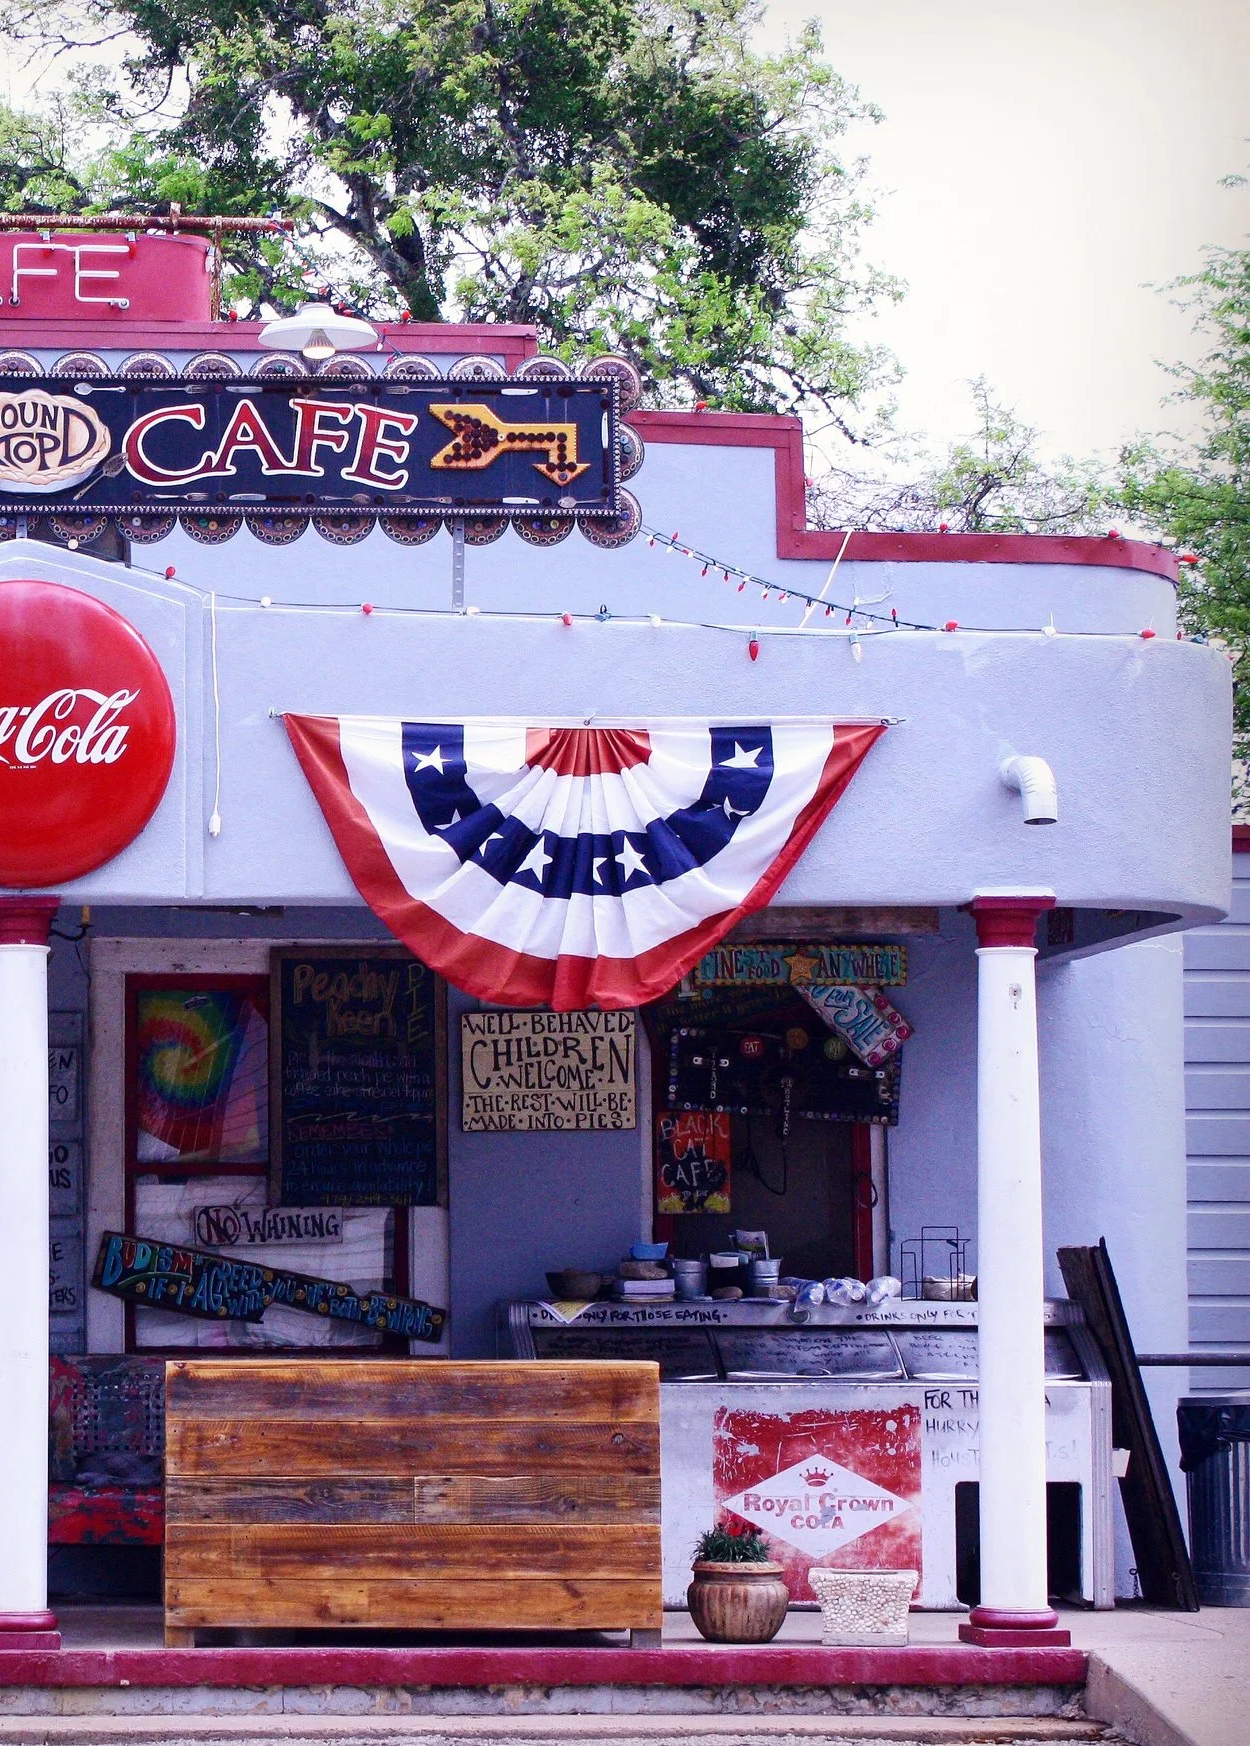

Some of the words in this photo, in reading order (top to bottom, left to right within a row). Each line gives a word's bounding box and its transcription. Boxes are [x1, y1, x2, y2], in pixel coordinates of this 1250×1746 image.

[122, 398, 419, 490] CAFE
[749, 959, 782, 978] FOOD
[817, 950, 898, 980] ANYWHERE
[294, 962, 401, 1014] Peachy
[406, 963, 430, 1042] PIE
[326, 1002, 397, 1038] Keen
[463, 1014, 520, 1035] WELL
[531, 1012, 630, 1034] BEHAVED
[834, 1000, 890, 1050] SALE
[471, 1035, 632, 1089] CHILDREN
[498, 1060, 596, 1090] WELCOME
[469, 1095, 504, 1113] THE
[511, 1093, 552, 1112] REST
[556, 1092, 602, 1112] WILL
[608, 1093, 628, 1112] BE
[468, 1115, 516, 1130] MADE
[528, 1112, 564, 1129] INTO
[575, 1112, 623, 1129] PIES
[661, 1114, 729, 1141] BLACK
[673, 1138, 710, 1160] CAT
[205, 1208, 239, 1244] NO
[241, 1208, 340, 1243] WHINING
[148, 1278, 168, 1300] IF
[610, 1310, 634, 1321] FOR
[675, 1309, 721, 1323] EATING
[925, 1389, 953, 1409] FOR
[743, 1494, 810, 1517] Royal
[819, 1493, 894, 1512] Crown
